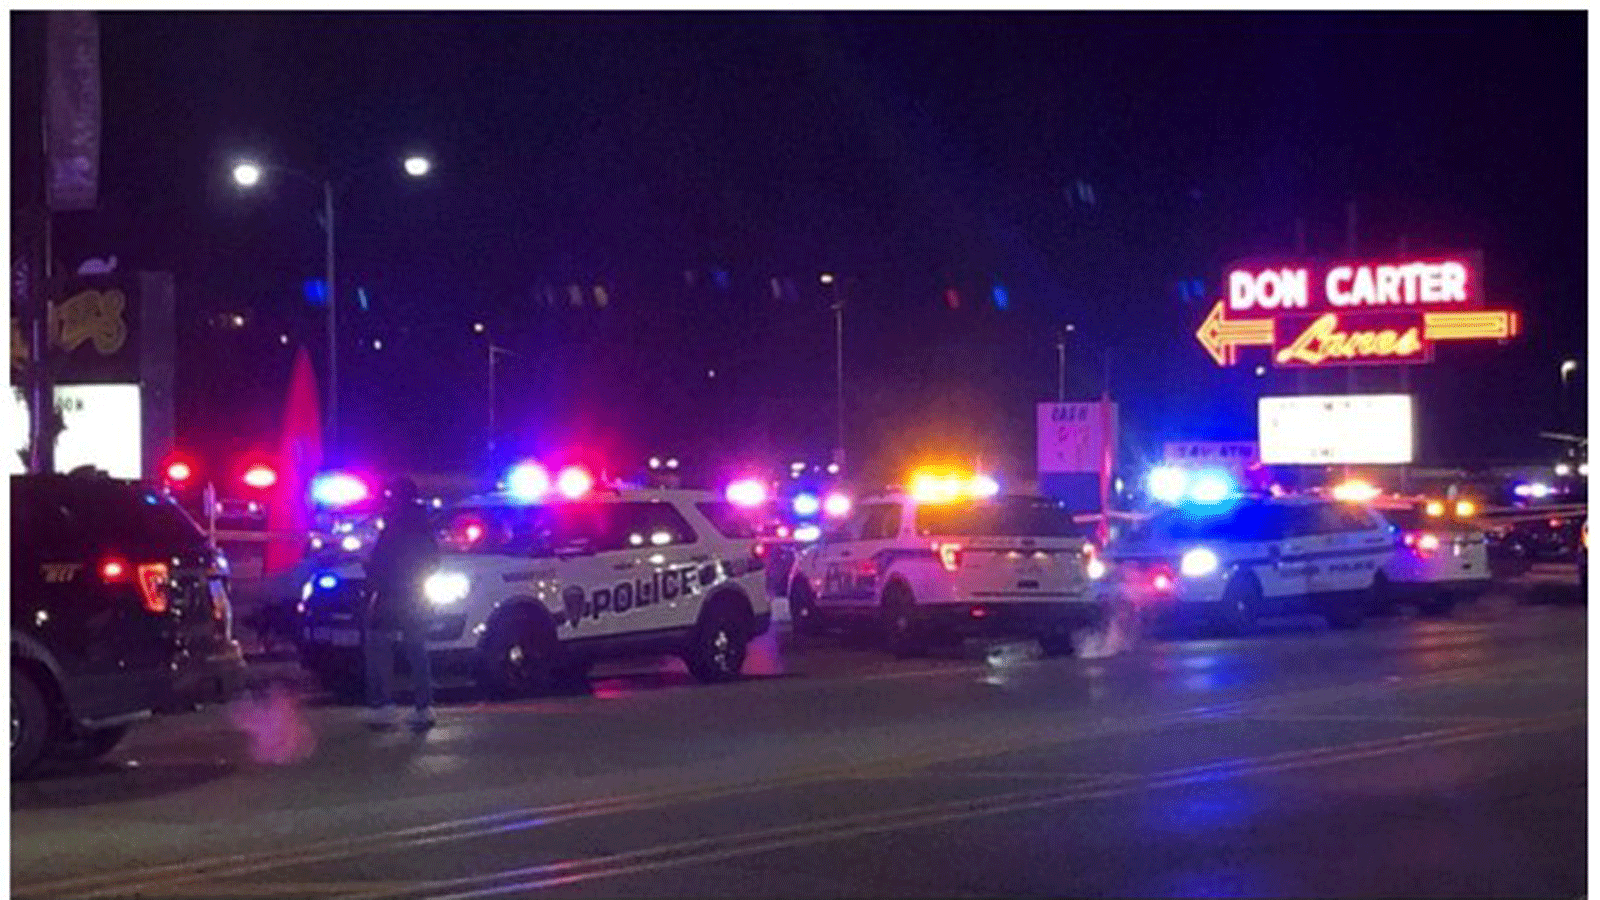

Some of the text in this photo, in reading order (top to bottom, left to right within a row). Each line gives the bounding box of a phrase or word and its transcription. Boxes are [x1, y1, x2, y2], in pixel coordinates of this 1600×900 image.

[1229, 261, 1467, 311] DON CARTER
[1275, 313, 1422, 365] Lanes
[592, 564, 699, 620] POLICE
